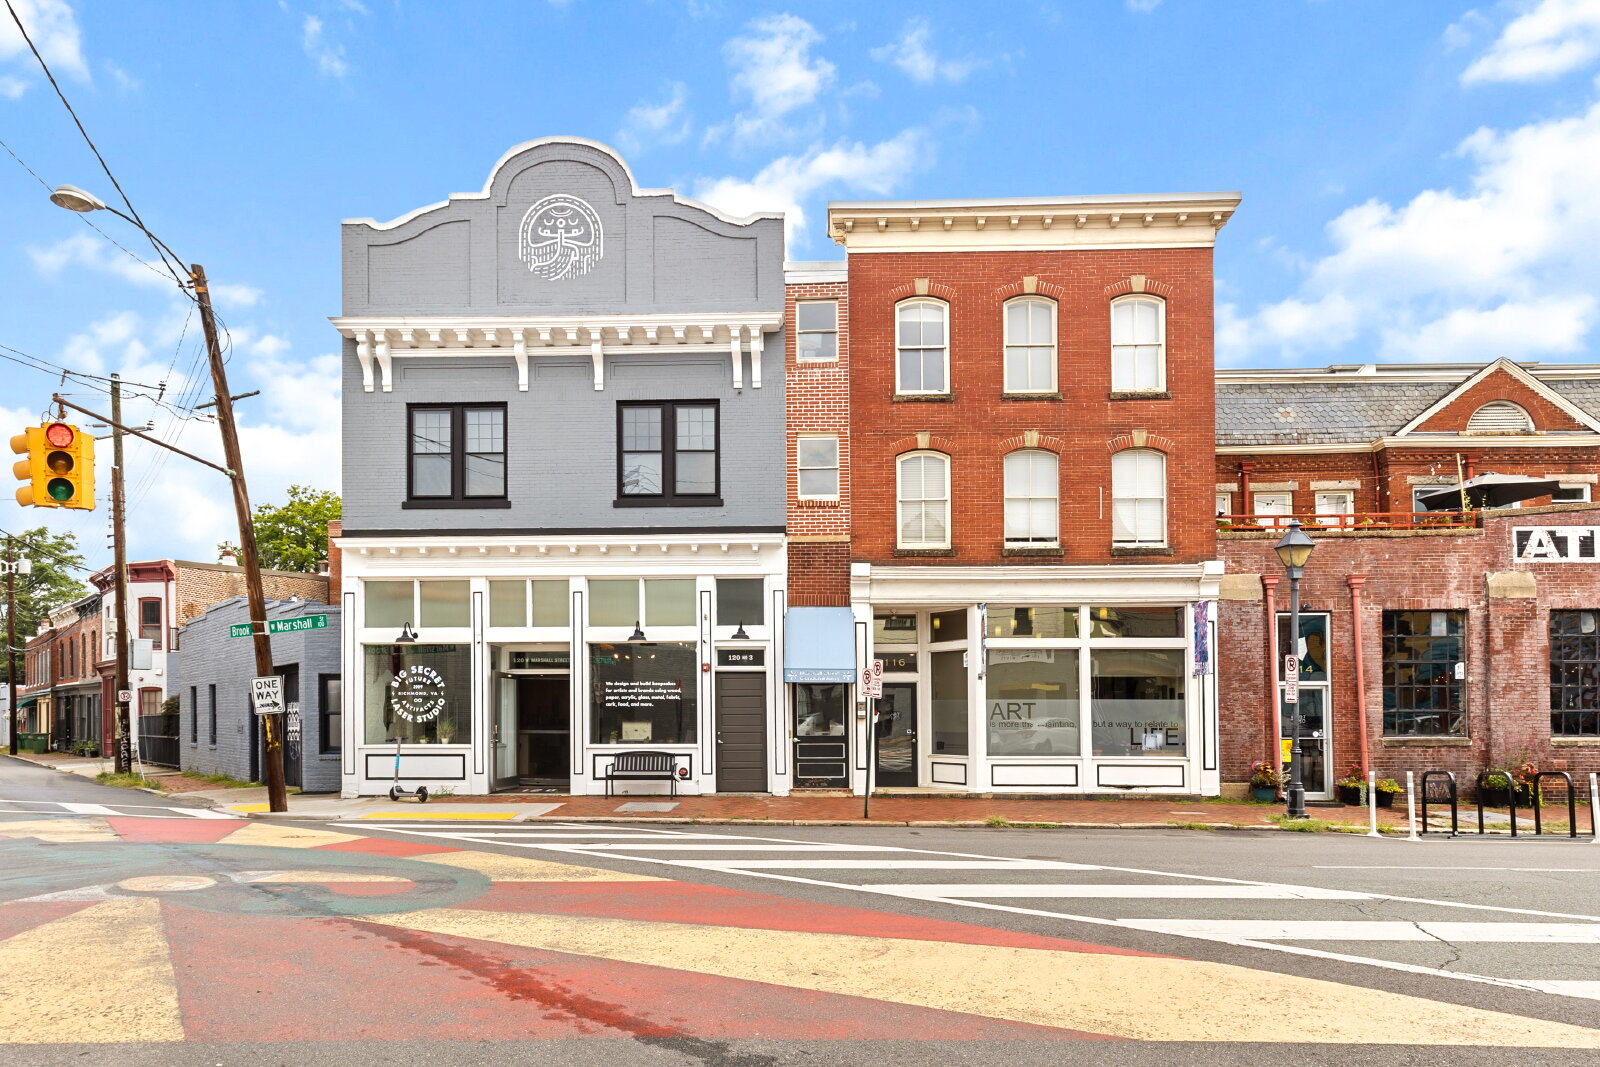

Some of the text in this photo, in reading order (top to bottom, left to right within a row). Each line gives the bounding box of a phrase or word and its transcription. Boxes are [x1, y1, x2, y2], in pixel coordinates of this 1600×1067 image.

[276, 618, 312, 631] Marshall
[232, 626, 250, 636] Brook
[885, 658, 905, 666] 116
[391, 666, 445, 688] BIG SECRET
[405, 676, 431, 684] FUTURE
[256, 680, 278, 689] ONE
[256, 691, 278, 700] WAY
[391, 698, 445, 722] LASER STUDIO
[402, 700, 434, 712] ARTIFACTS
[990, 703, 1036, 720] ART
